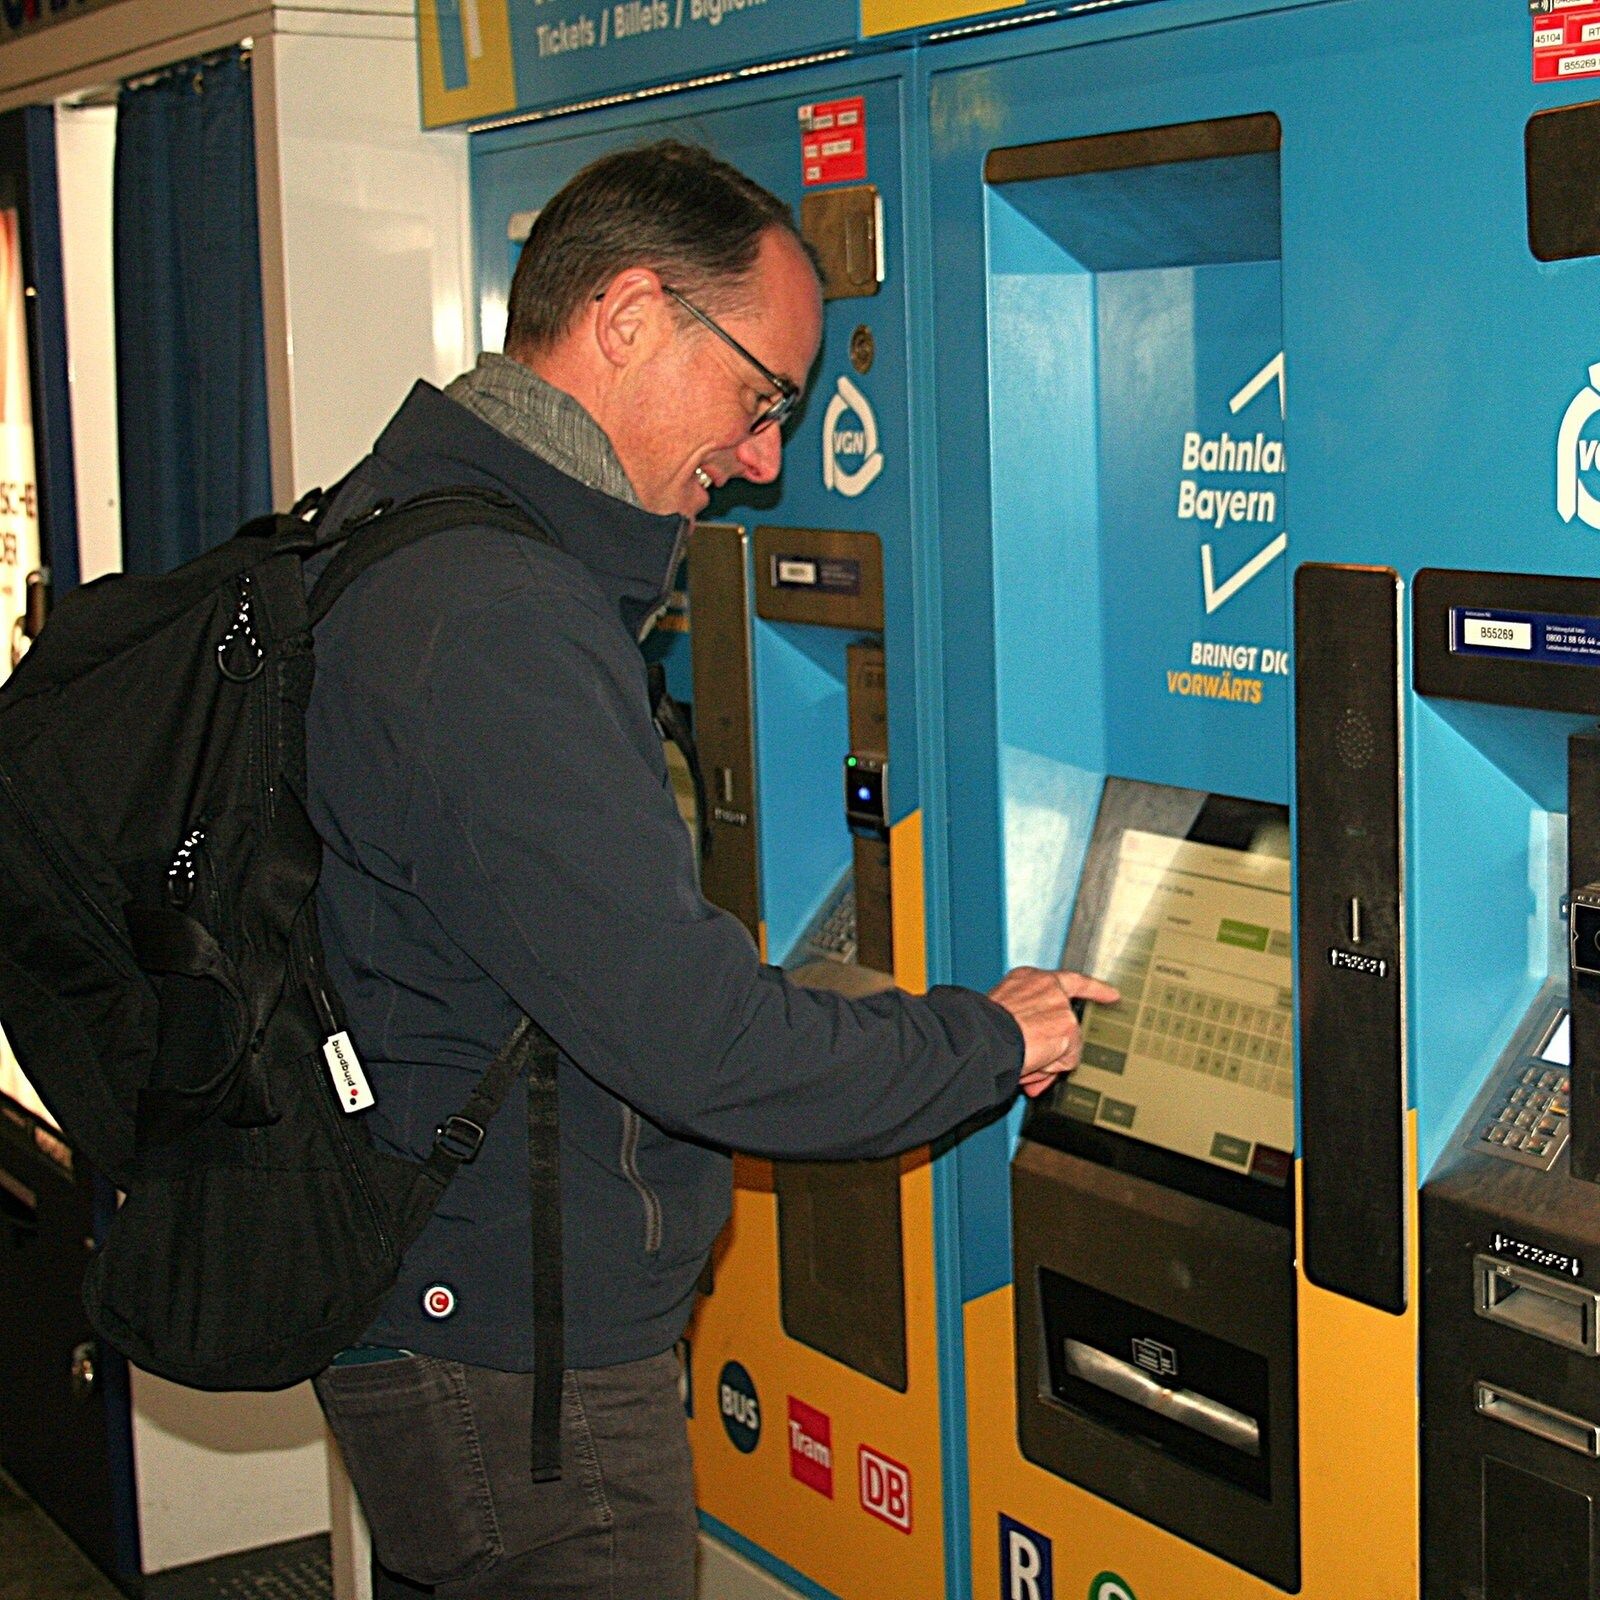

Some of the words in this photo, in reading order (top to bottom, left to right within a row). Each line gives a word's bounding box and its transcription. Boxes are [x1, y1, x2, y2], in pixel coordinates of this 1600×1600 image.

[536, 15, 595, 57] Tickets
[613, 1, 669, 38] Billets
[1535, 33, 1561, 44] 45104
[1564, 58, 1596, 71] B55269
[832, 430, 864, 455] VGN
[1181, 431, 1286, 473] Bahnla
[1177, 478, 1275, 529] Bayern
[1480, 626, 1514, 641] B55269
[1190, 642, 1257, 672] BRINGT
[1166, 670, 1264, 705] VORWÄRTS
[331, 1039, 356, 1087] pingpong
[721, 1384, 759, 1431] BUS
[788, 1418, 832, 1469] Tram
[866, 1458, 906, 1520] DB
[1008, 1529, 1042, 1600] R
